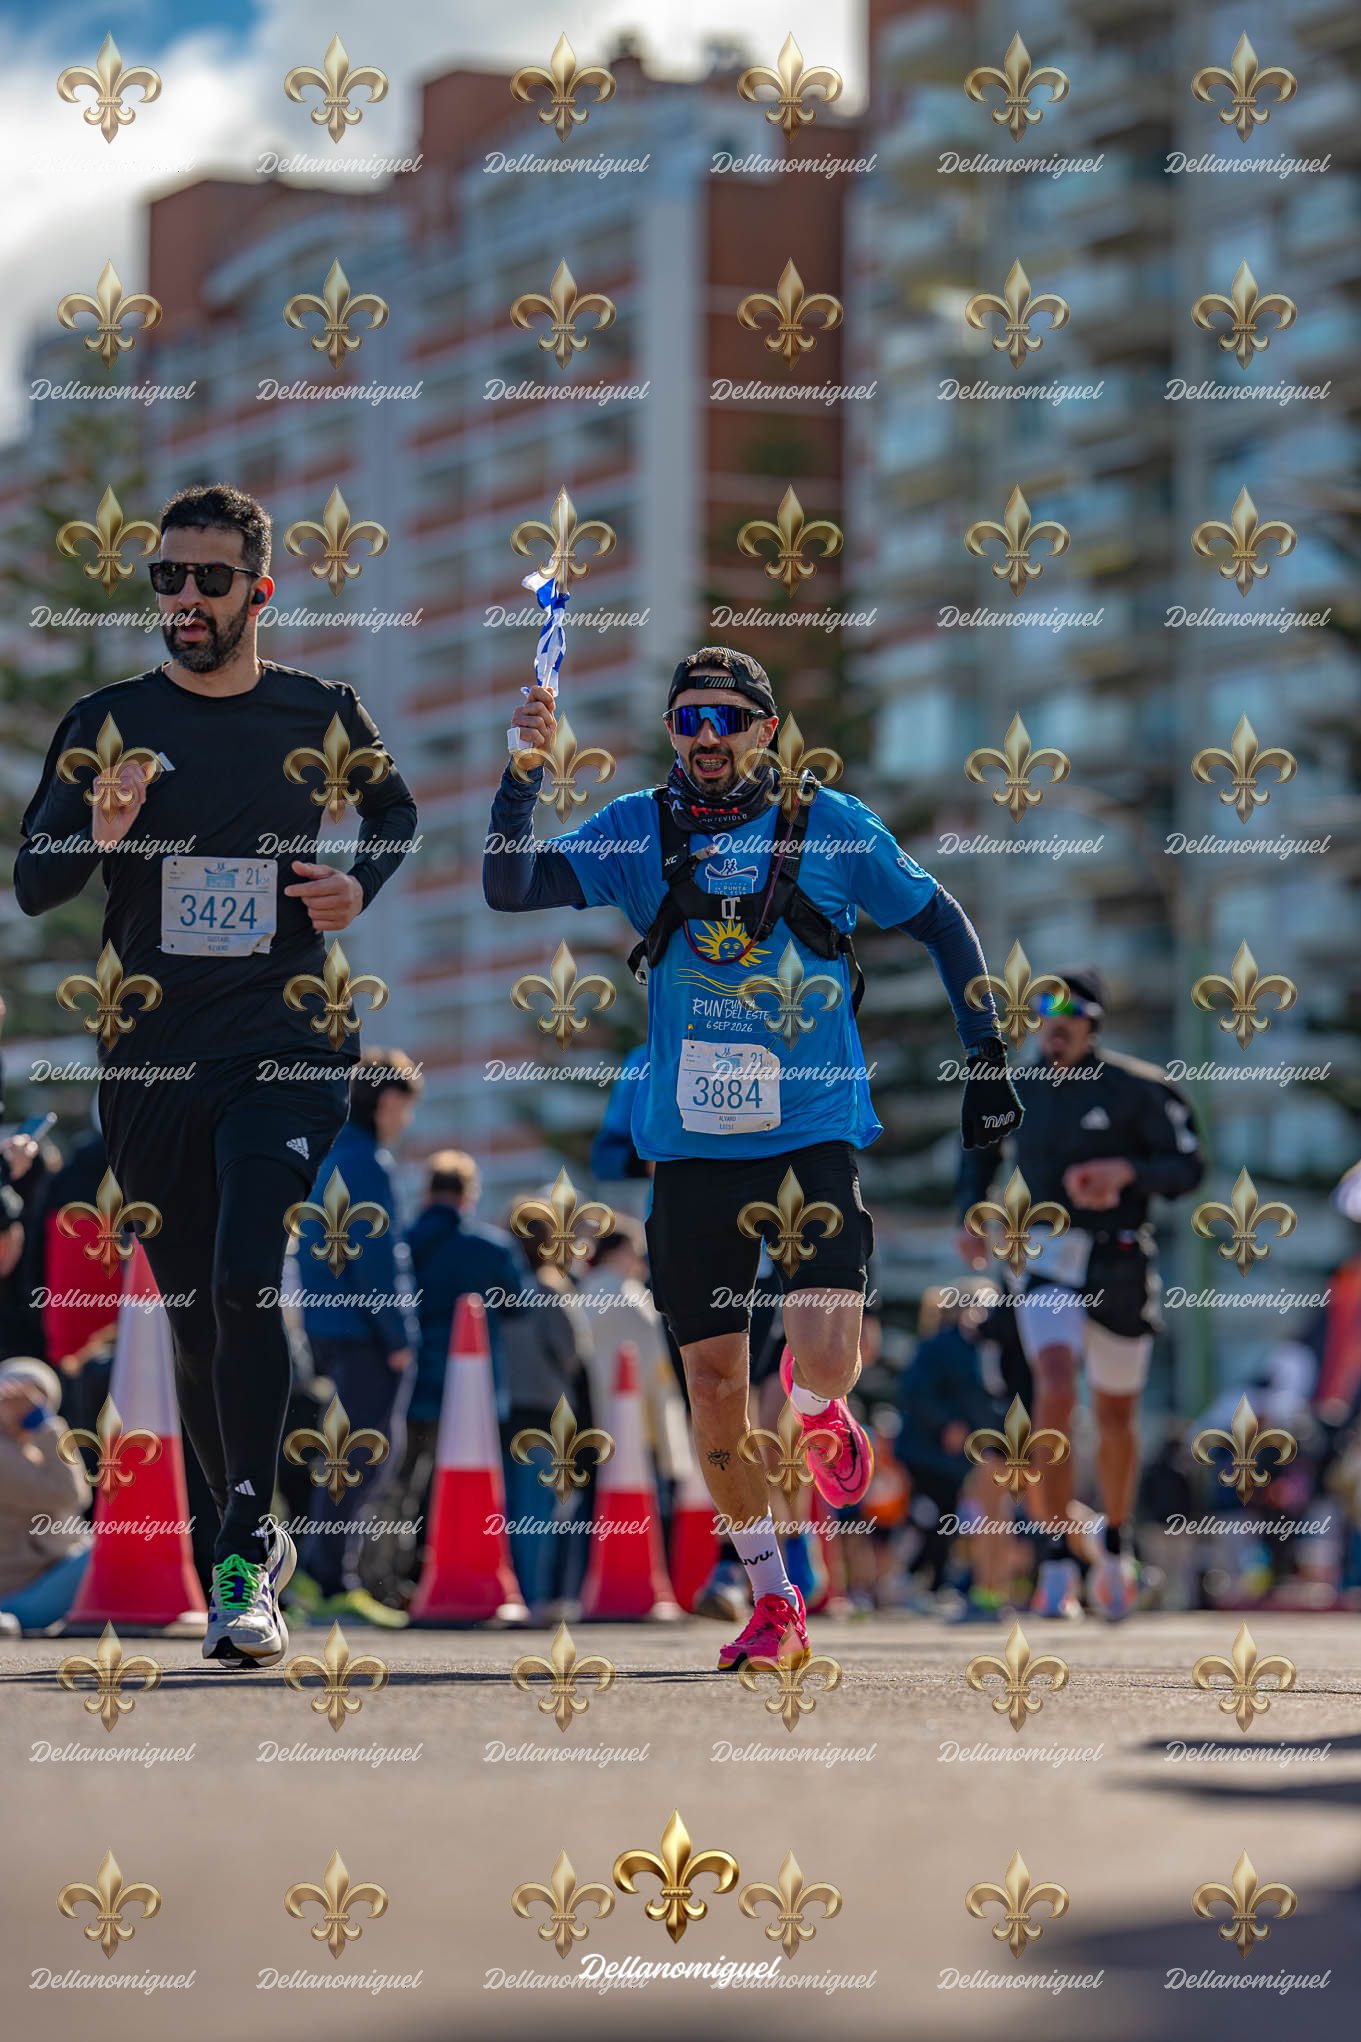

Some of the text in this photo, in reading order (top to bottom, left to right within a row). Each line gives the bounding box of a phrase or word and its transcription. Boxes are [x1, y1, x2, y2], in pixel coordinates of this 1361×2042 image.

[245, 867, 260, 885] 21
[180, 894, 257, 929] 3424
[692, 997, 725, 1018] RUN
[725, 1008, 769, 1020] DEL ESTE
[706, 1021, 712, 1029] 6
[730, 1022, 753, 1032] 2026
[693, 1076, 763, 1109] 3884
